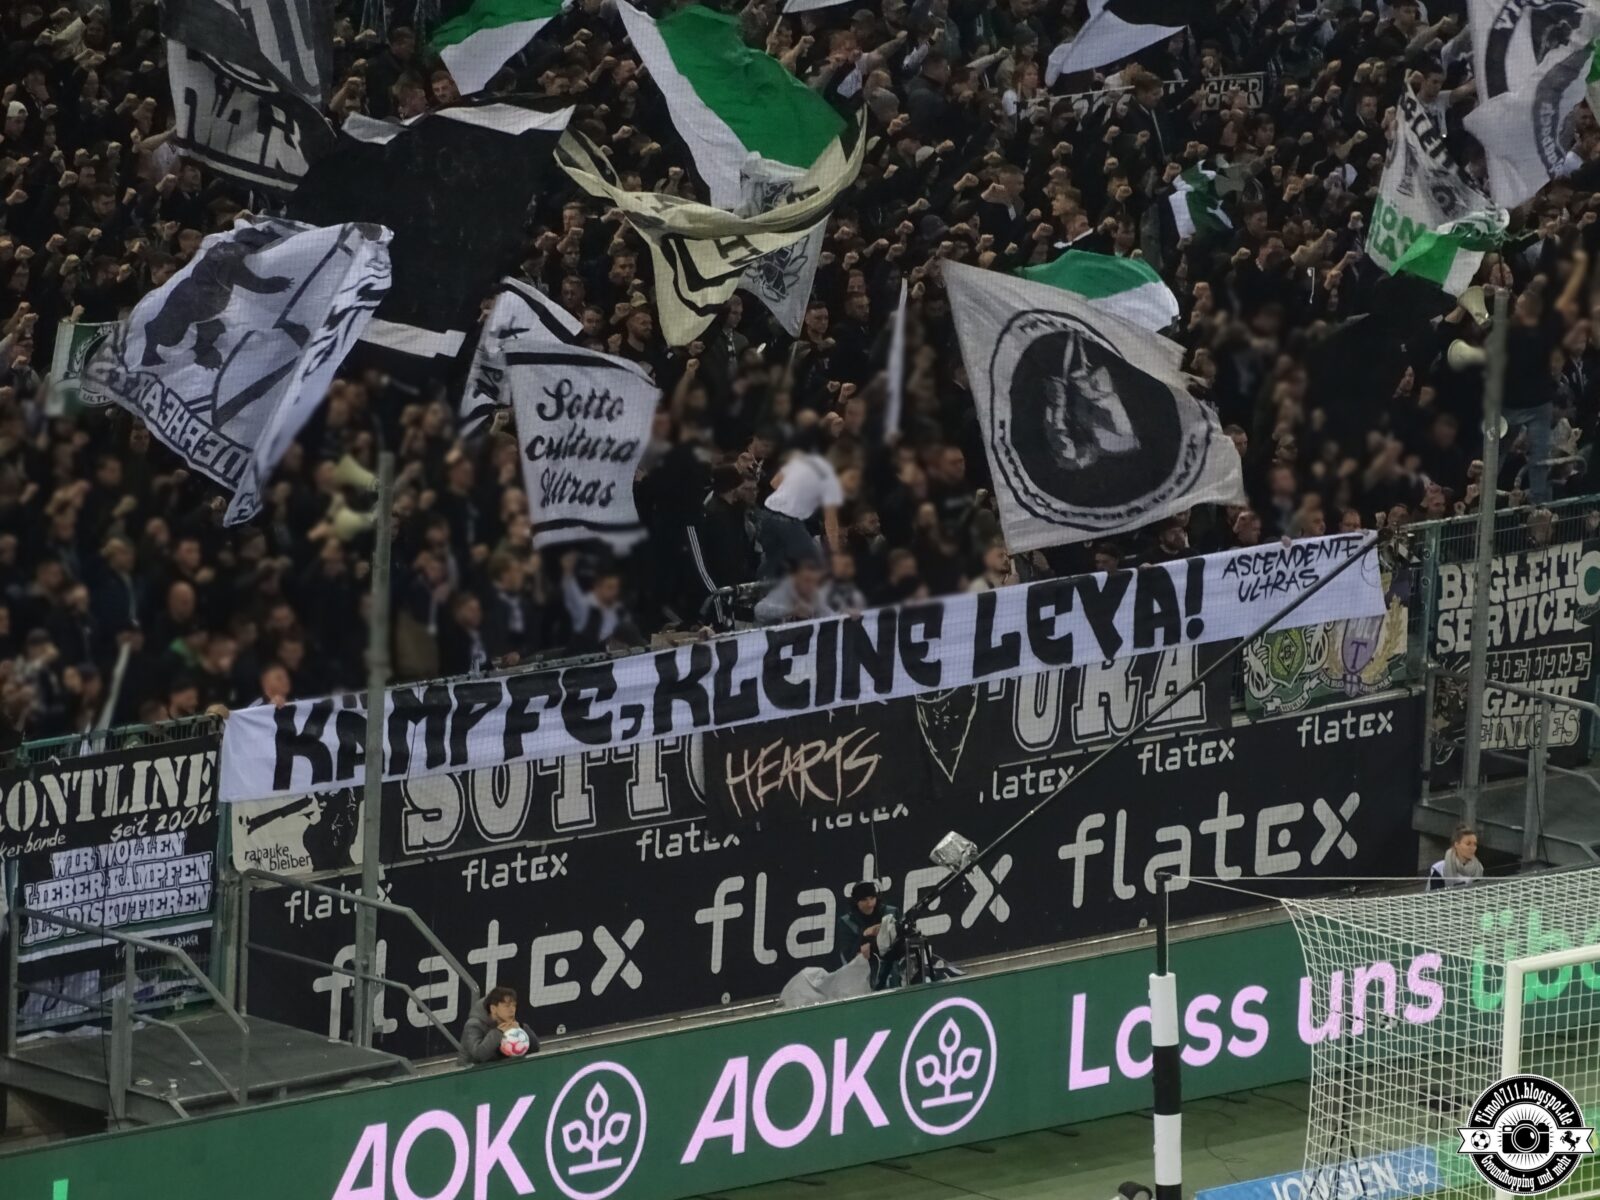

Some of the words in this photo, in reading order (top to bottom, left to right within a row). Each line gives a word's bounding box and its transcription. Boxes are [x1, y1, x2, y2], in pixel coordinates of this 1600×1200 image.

[537, 379, 624, 422] Sotto
[526, 423, 640, 462] cultura
[1222, 535, 1364, 579] ASCENDENTE
[1436, 586, 1577, 655] SERVICE
[653, 602, 945, 736] KLEINE
[972, 557, 1207, 680] LEYA!
[1298, 709, 1393, 747] flatex
[725, 727, 883, 818] HEARTS
[1138, 737, 1236, 775] flatex
[0, 751, 217, 832] ONTLINE
[979, 765, 1075, 803] latex
[110, 814, 149, 842] seit
[155, 803, 212, 833] 2006
[51, 846, 95, 879] WIR
[98, 831, 187, 868] WOLLEN
[462, 852, 569, 892] flatex
[1058, 791, 1361, 908] flatex
[25, 872, 105, 910] LIEBER
[65, 883, 211, 934] DISKUTIEREN
[1297, 951, 1445, 1045] uns
[680, 1029, 891, 1165] AOK
[331, 1094, 537, 1200] AOK
